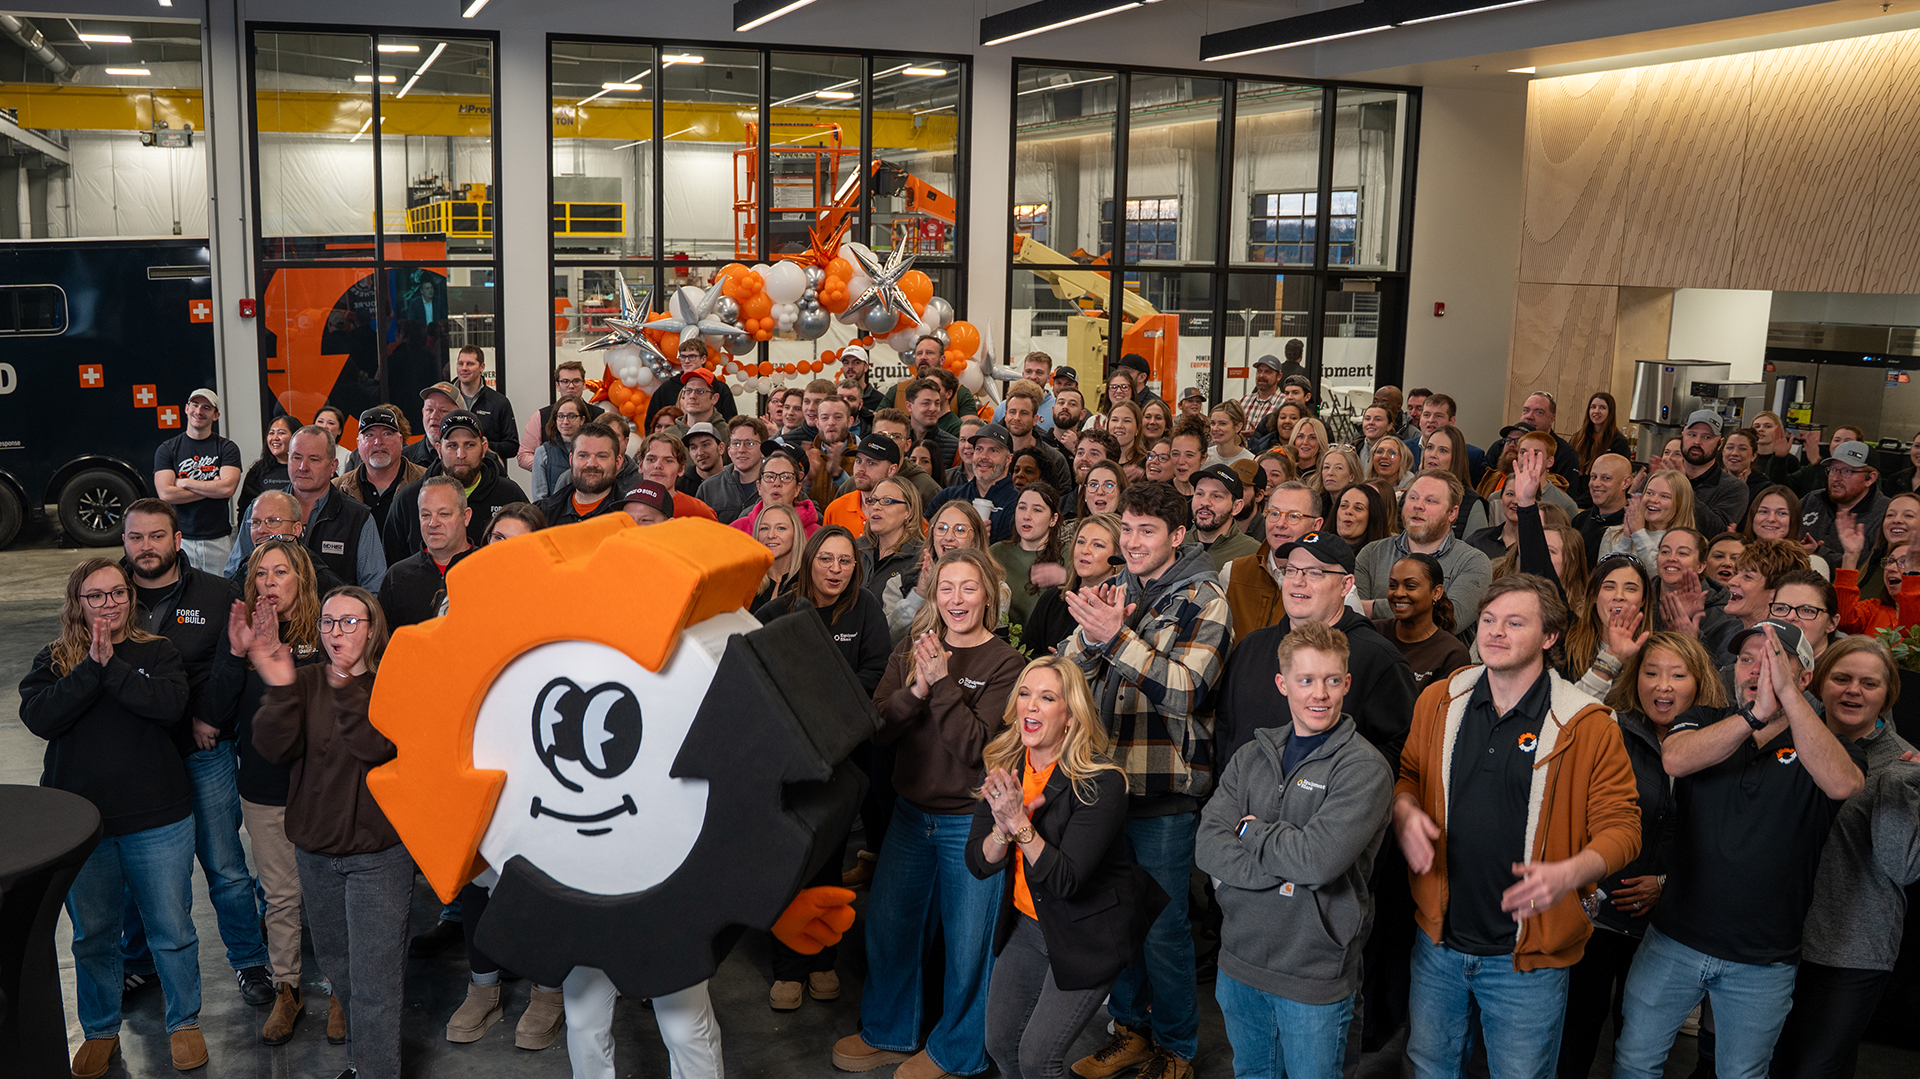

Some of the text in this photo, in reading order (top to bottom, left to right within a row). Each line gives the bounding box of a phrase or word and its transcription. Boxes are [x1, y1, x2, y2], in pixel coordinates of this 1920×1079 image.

[555, 117, 574, 126] TON
[178, 455, 219, 472] Better
[176, 609, 200, 617] FORGE
[185, 617, 206, 625] BUILD
